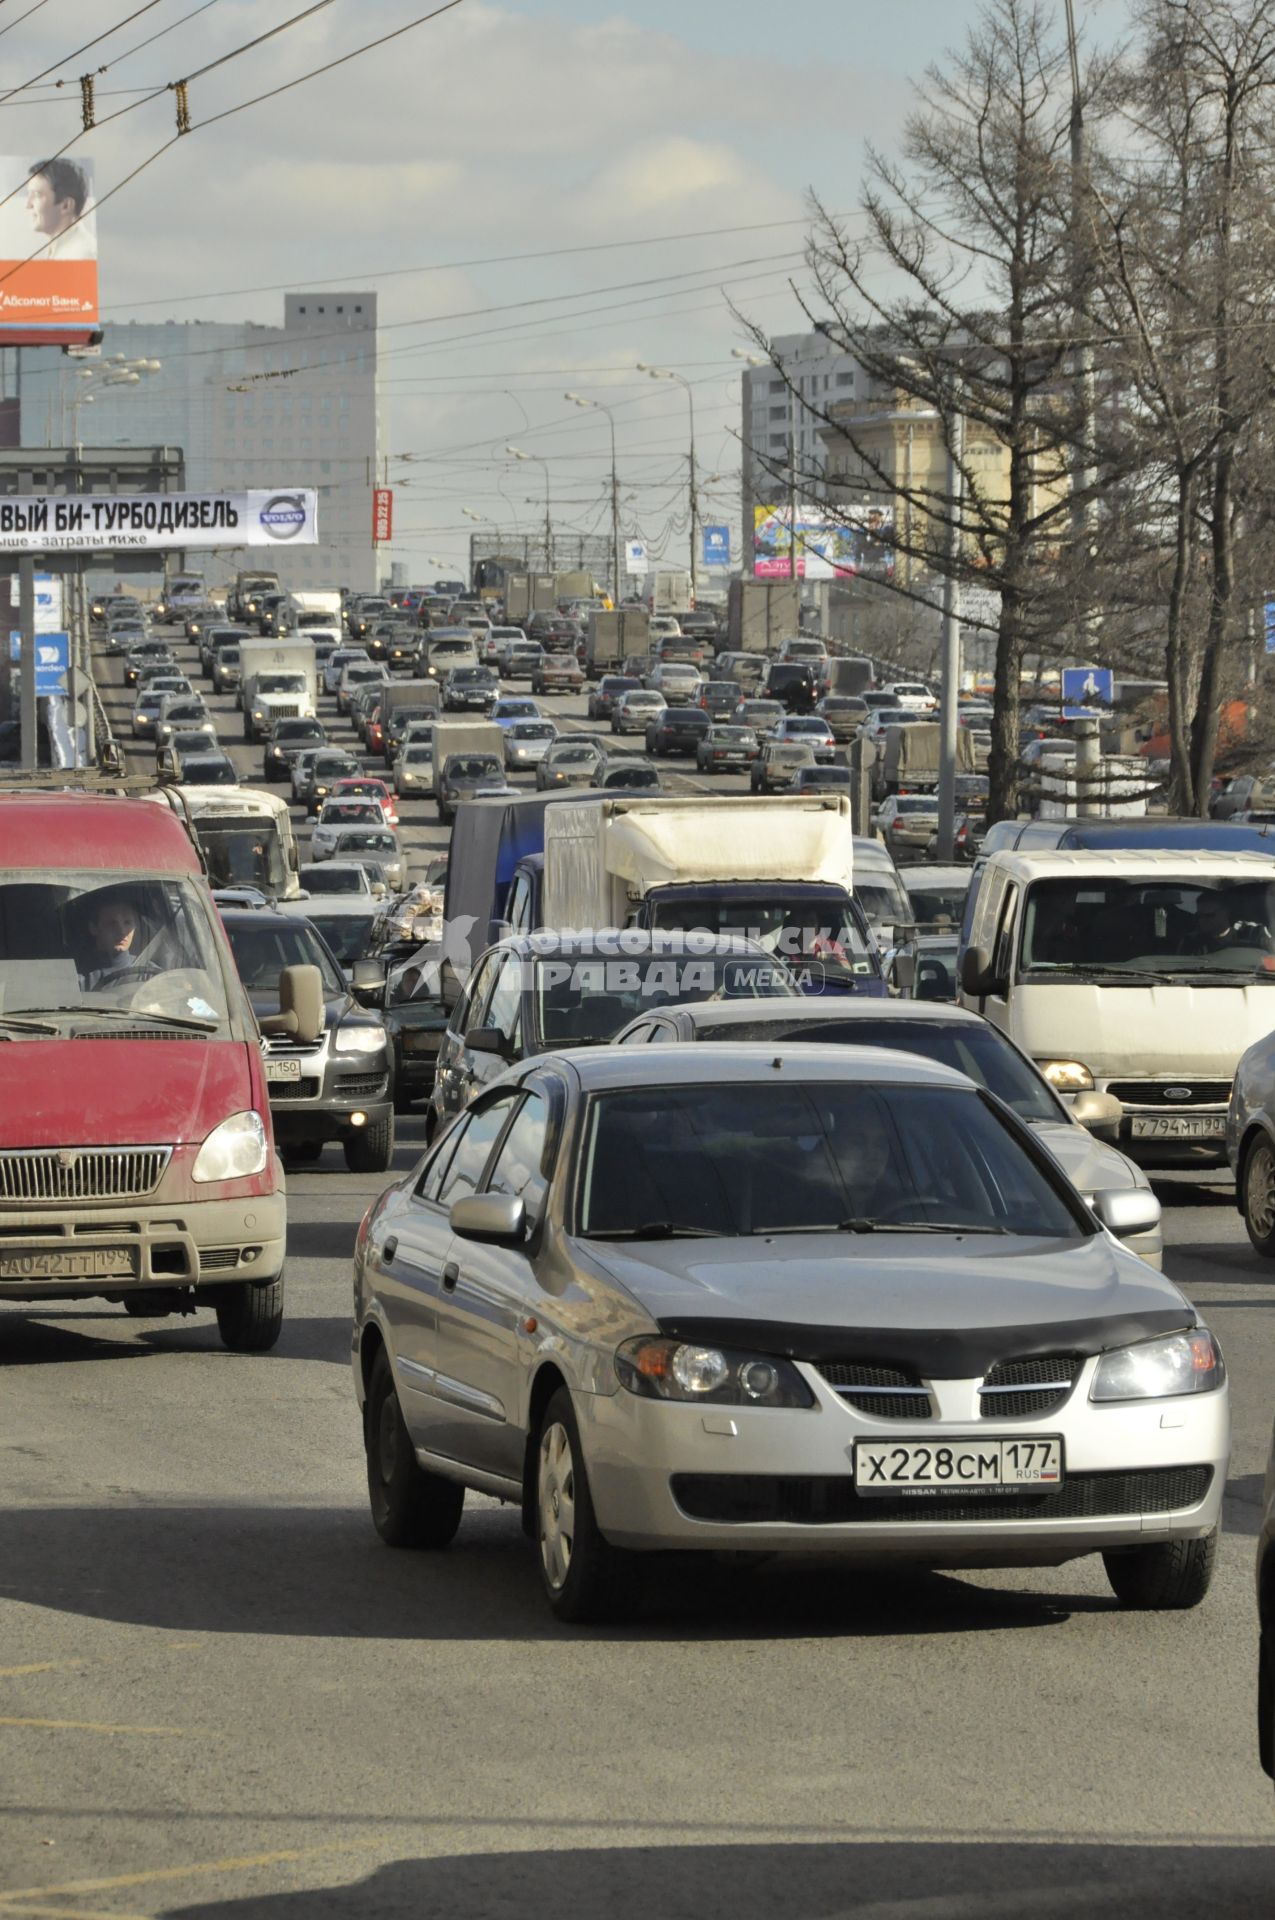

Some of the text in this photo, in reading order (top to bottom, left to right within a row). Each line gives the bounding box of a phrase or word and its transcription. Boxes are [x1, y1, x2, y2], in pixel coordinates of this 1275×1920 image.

[52, 295, 80, 305] Банк
[1, 498, 238, 534] ВЫЙ БИ-ТУРБОДИЗЕЛЬ
[262, 513, 304, 522] VOLVO
[42, 535, 104, 548] затраты
[277, 1062, 297, 1072] 150
[1139, 1119, 1200, 1135] У794МТ
[1205, 1118, 1221, 1130] 90
[97, 1249, 128, 1266] 199
[868, 1443, 1053, 1481] Х228СМ 177
[1016, 1469, 1040, 1479] RUS
[901, 1488, 937, 1496] NISSAN
